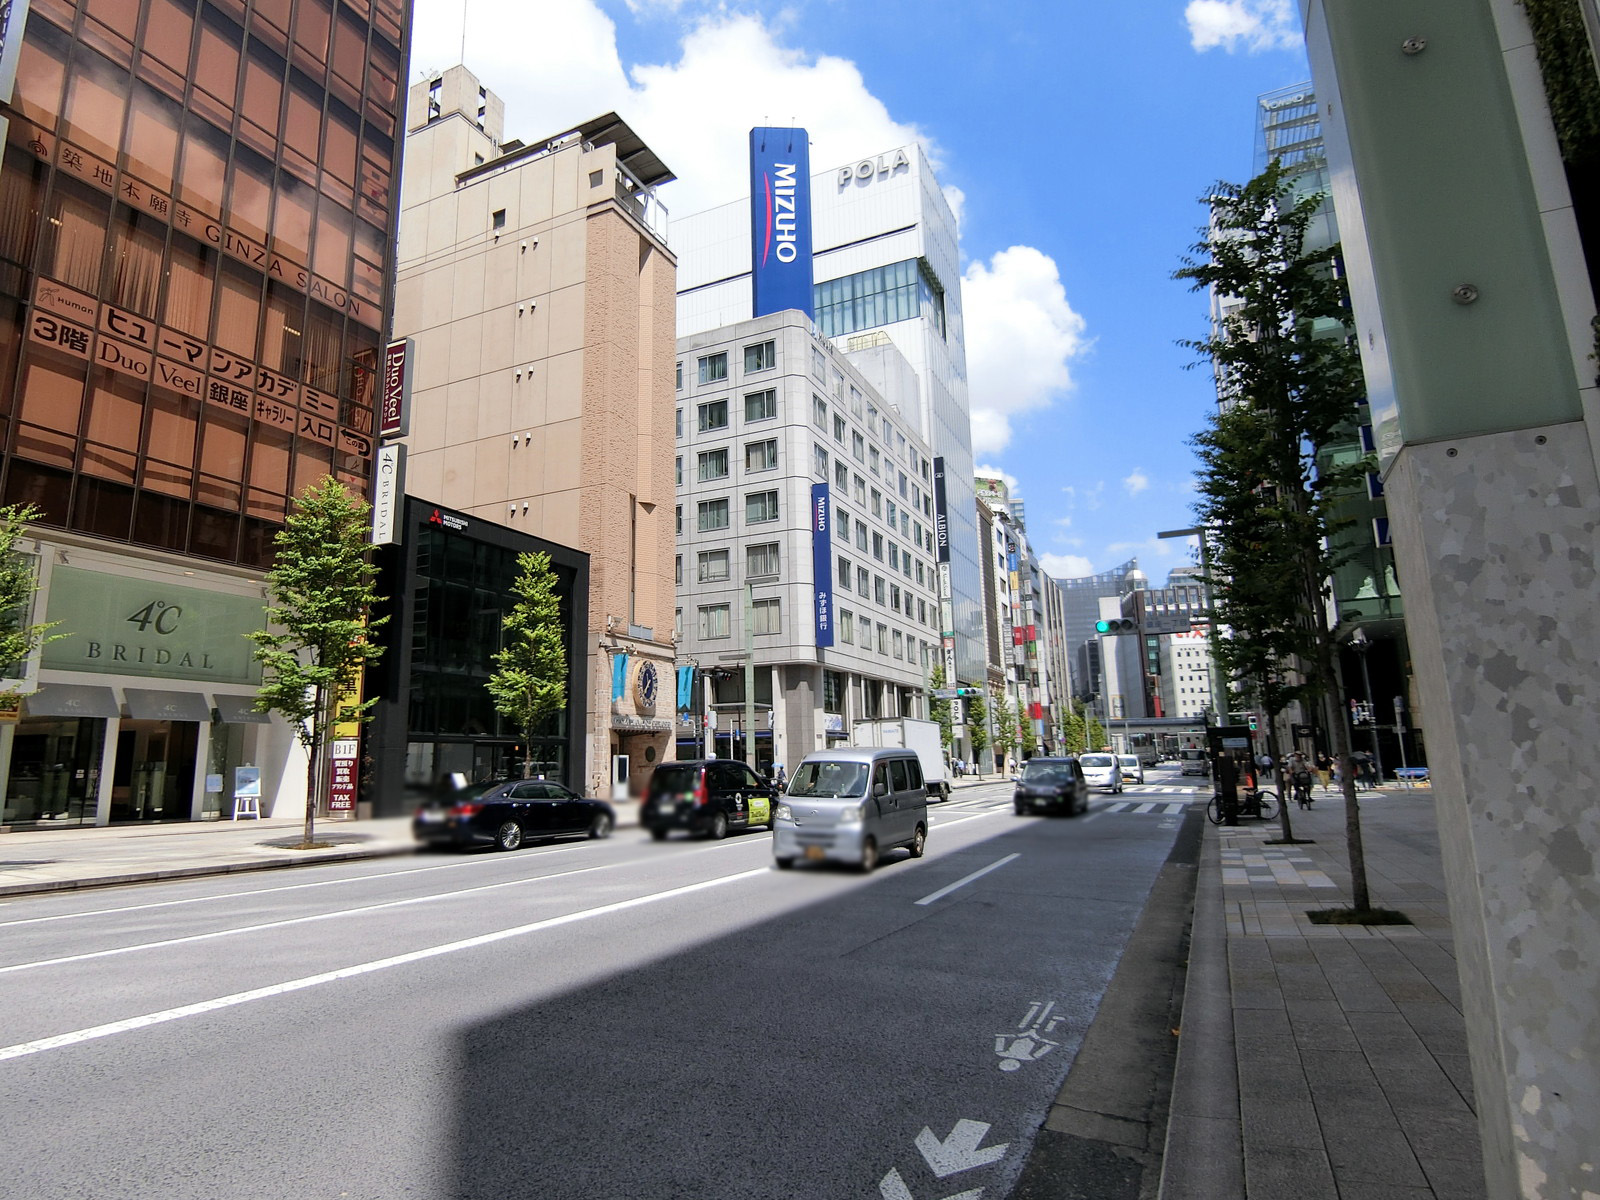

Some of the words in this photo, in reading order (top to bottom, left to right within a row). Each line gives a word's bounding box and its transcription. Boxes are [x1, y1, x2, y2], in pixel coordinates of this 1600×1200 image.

[838, 149, 909, 186] POLA
[774, 163, 797, 263] MIZUHO
[62, 148, 192, 228] 築地本願寺
[205, 225, 283, 277] GINZA
[296, 272, 360, 316] SALON
[108, 308, 335, 411] ヒューマンアカデミー
[390, 351, 404, 387] Duo
[33, 316, 89, 354] 3階
[100, 341, 148, 375] Duo
[158, 362, 201, 395] Veel
[209, 382, 249, 412] 銀座
[256, 400, 293, 424] ギャラリー
[301, 416, 332, 442] 入口
[388, 384, 403, 422] Veel
[379, 480, 389, 539] BRIDAL
[443, 520, 462, 530] MOTORS
[817, 497, 825, 532] MIZUHO
[937, 513, 947, 547] ALBION
[819, 591, 828, 630] みずほ銀行
[88, 641, 214, 670] BRIDAL
[335, 744, 356, 755] B1F
[332, 801, 351, 809] FREE
